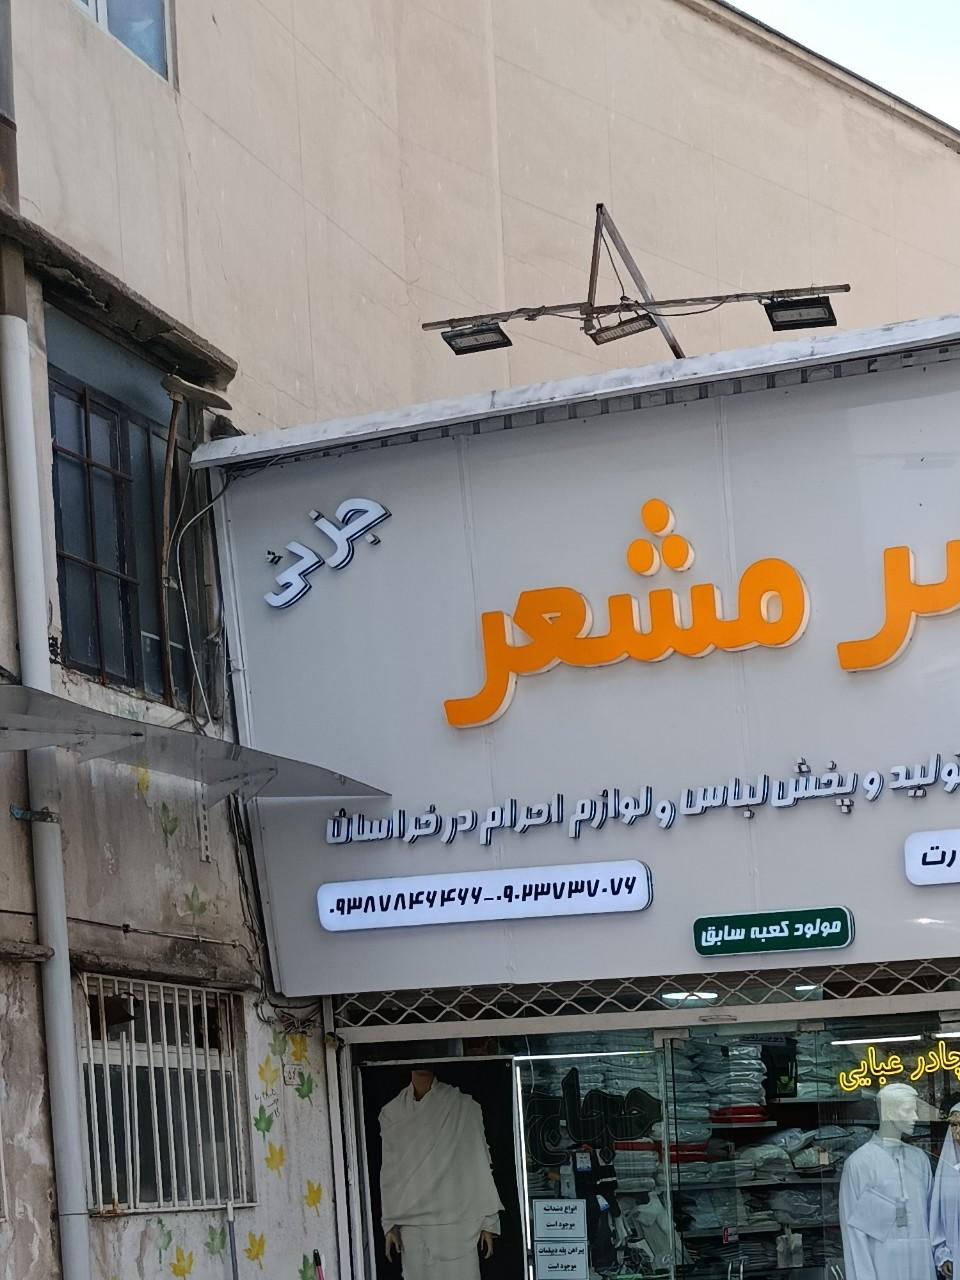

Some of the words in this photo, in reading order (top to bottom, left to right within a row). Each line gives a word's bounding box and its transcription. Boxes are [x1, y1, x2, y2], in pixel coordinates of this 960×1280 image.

[443, 498, 810, 728] مشعر
[679, 772, 770, 819] لباس
[770, 757, 858, 813] پخش
[862, 769, 885, 801] و
[325, 803, 443, 845] خراسان
[440, 808, 478, 845] در
[479, 793, 564, 845] احرام
[568, 785, 653, 838] لوازم
[655, 798, 676, 830] و
[701, 925, 746, 947] سابق
[750, 920, 790, 942] کعبه
[794, 917, 842, 937] مولود
[839, 1047, 904, 1092] عبایی
